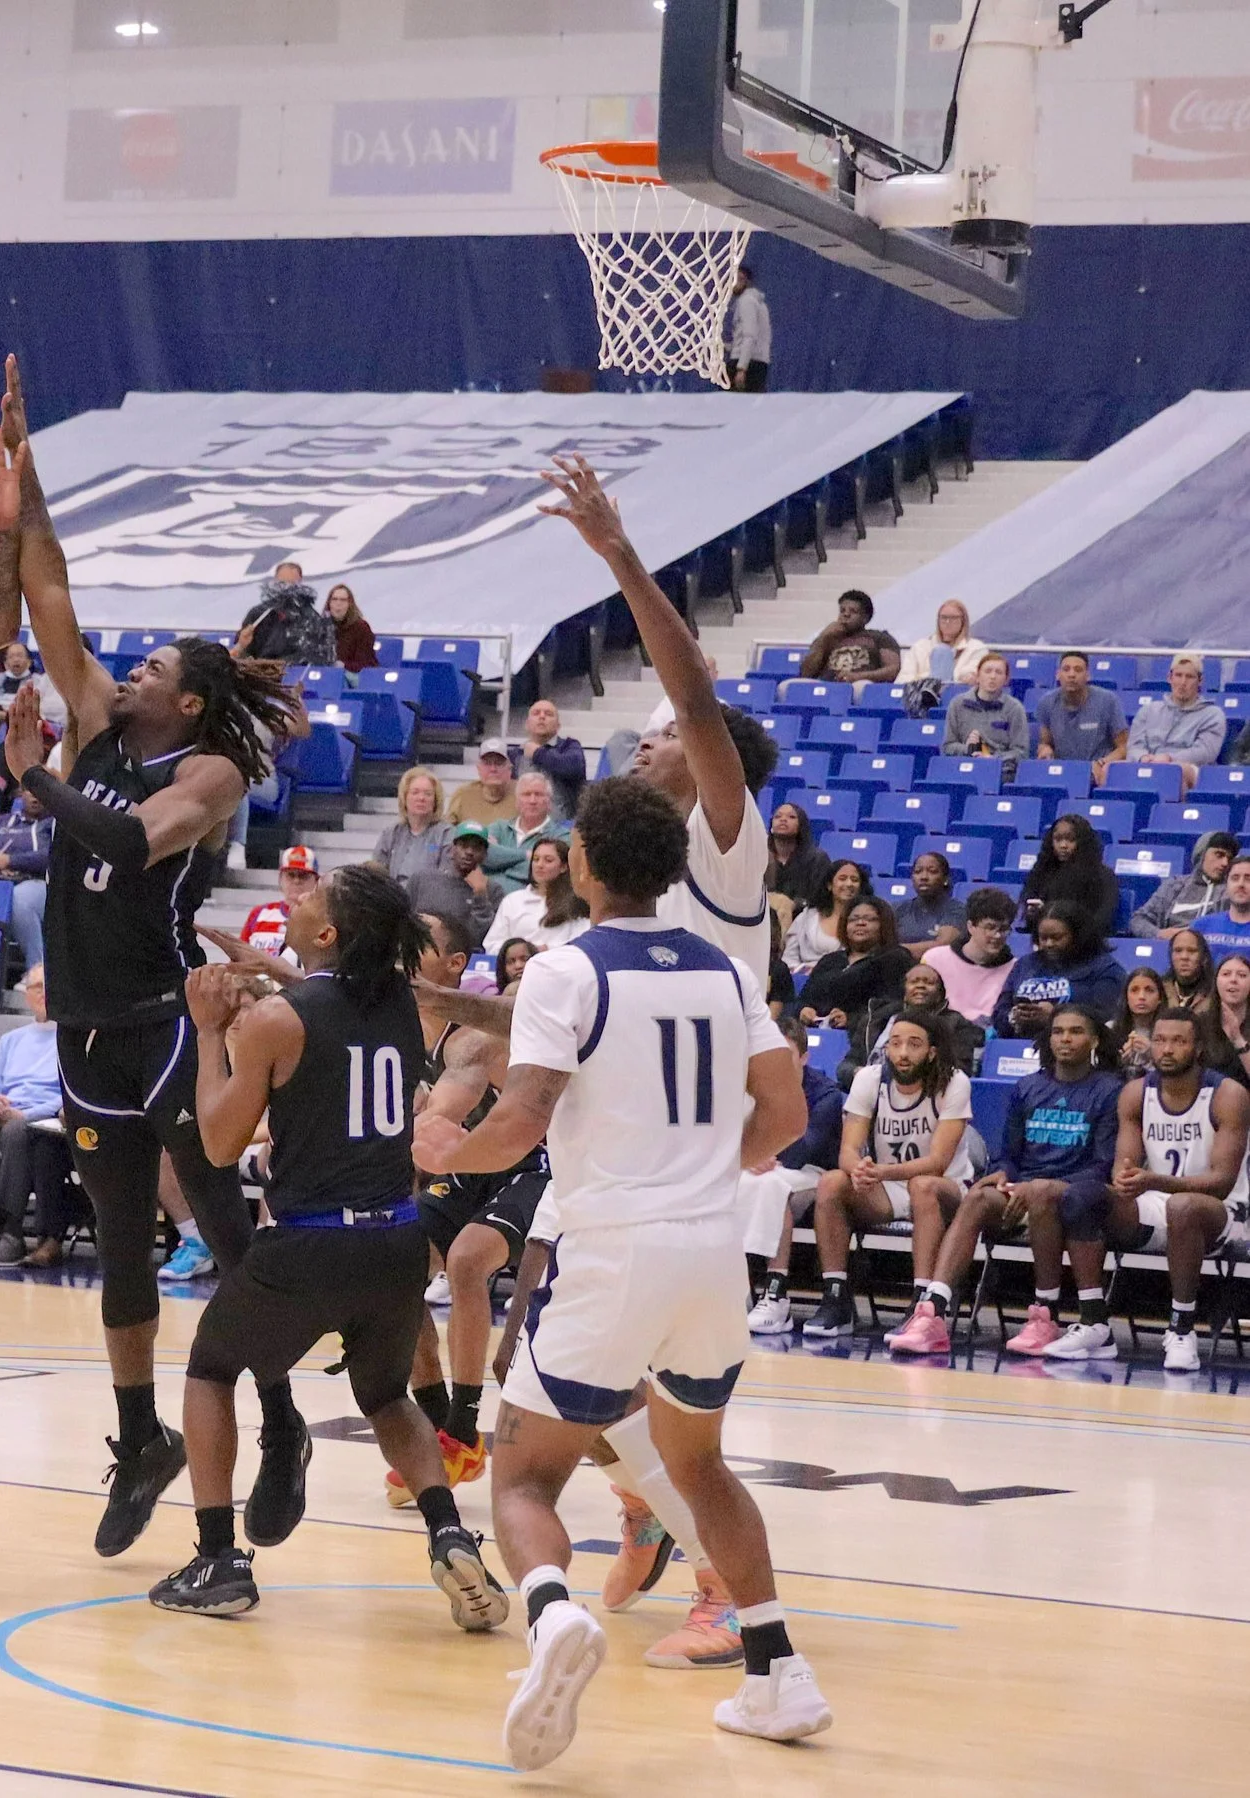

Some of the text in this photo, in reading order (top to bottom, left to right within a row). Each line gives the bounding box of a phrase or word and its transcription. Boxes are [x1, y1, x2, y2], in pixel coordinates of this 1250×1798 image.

[341, 121, 498, 168] DASANI
[1017, 978, 1070, 995] STAND
[347, 1045, 405, 1137] 10
[651, 1016, 714, 1127] 11
